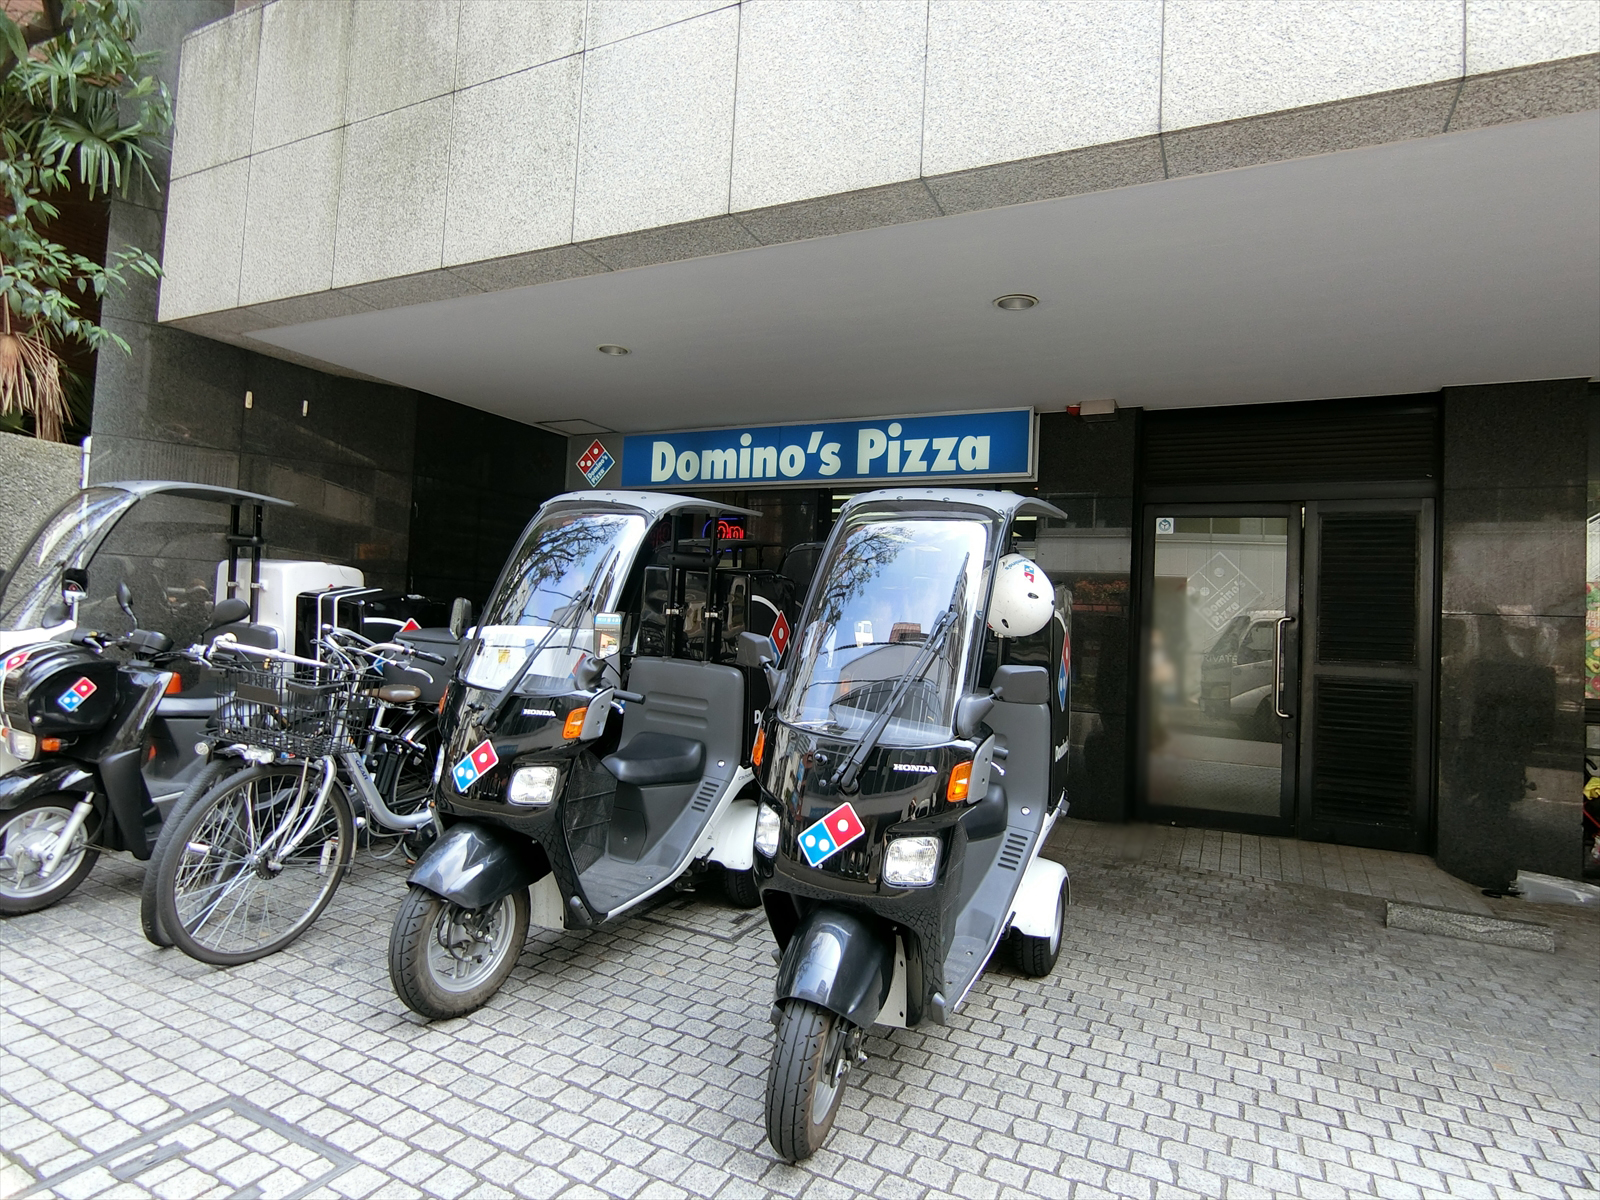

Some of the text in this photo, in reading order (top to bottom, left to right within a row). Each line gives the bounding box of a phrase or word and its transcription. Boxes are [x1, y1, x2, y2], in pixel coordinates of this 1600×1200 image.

[651, 422, 991, 482] Domino's Pizza
[587, 455, 608, 479] Domino's
[591, 467, 605, 484] Pizza
[1202, 579, 1246, 616] Domino's
[1210, 601, 1240, 626] Pizza
[1203, 653, 1238, 665] RIVATE
[522, 708, 557, 717] HONDA
[893, 763, 938, 774] HONDA
